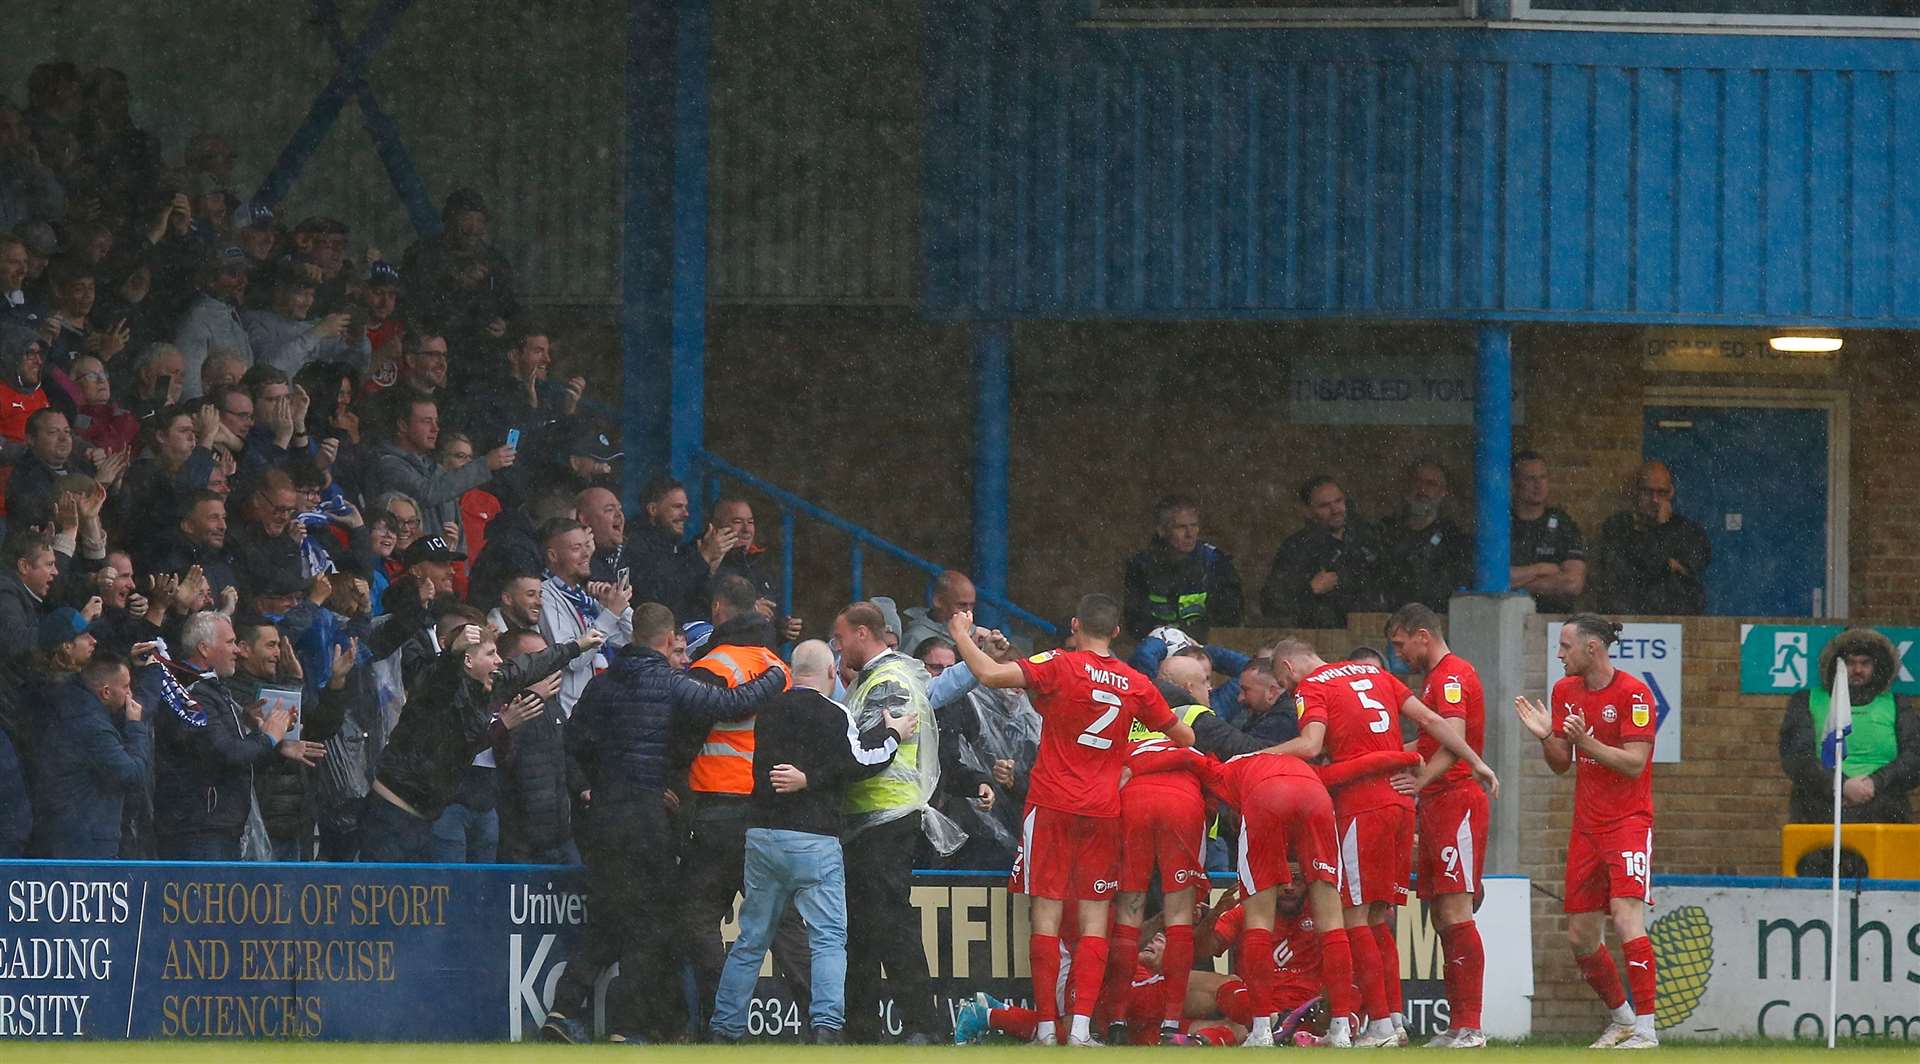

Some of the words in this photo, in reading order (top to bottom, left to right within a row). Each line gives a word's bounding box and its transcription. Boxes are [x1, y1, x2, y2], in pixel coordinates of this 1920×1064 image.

[1084, 663, 1129, 691] WATTS
[1077, 688, 1123, 750] 2
[1349, 678, 1391, 734] 5
[1441, 846, 1459, 873] 9
[1621, 850, 1646, 877] 10
[8, 880, 129, 924] SPORTS
[162, 882, 292, 925] SCHOOL
[301, 883, 342, 926] OF
[351, 884, 449, 926] SPORT
[161, 938, 230, 981] AND
[240, 939, 395, 982] EXERCISE
[162, 995, 323, 1037] SCIENCES
